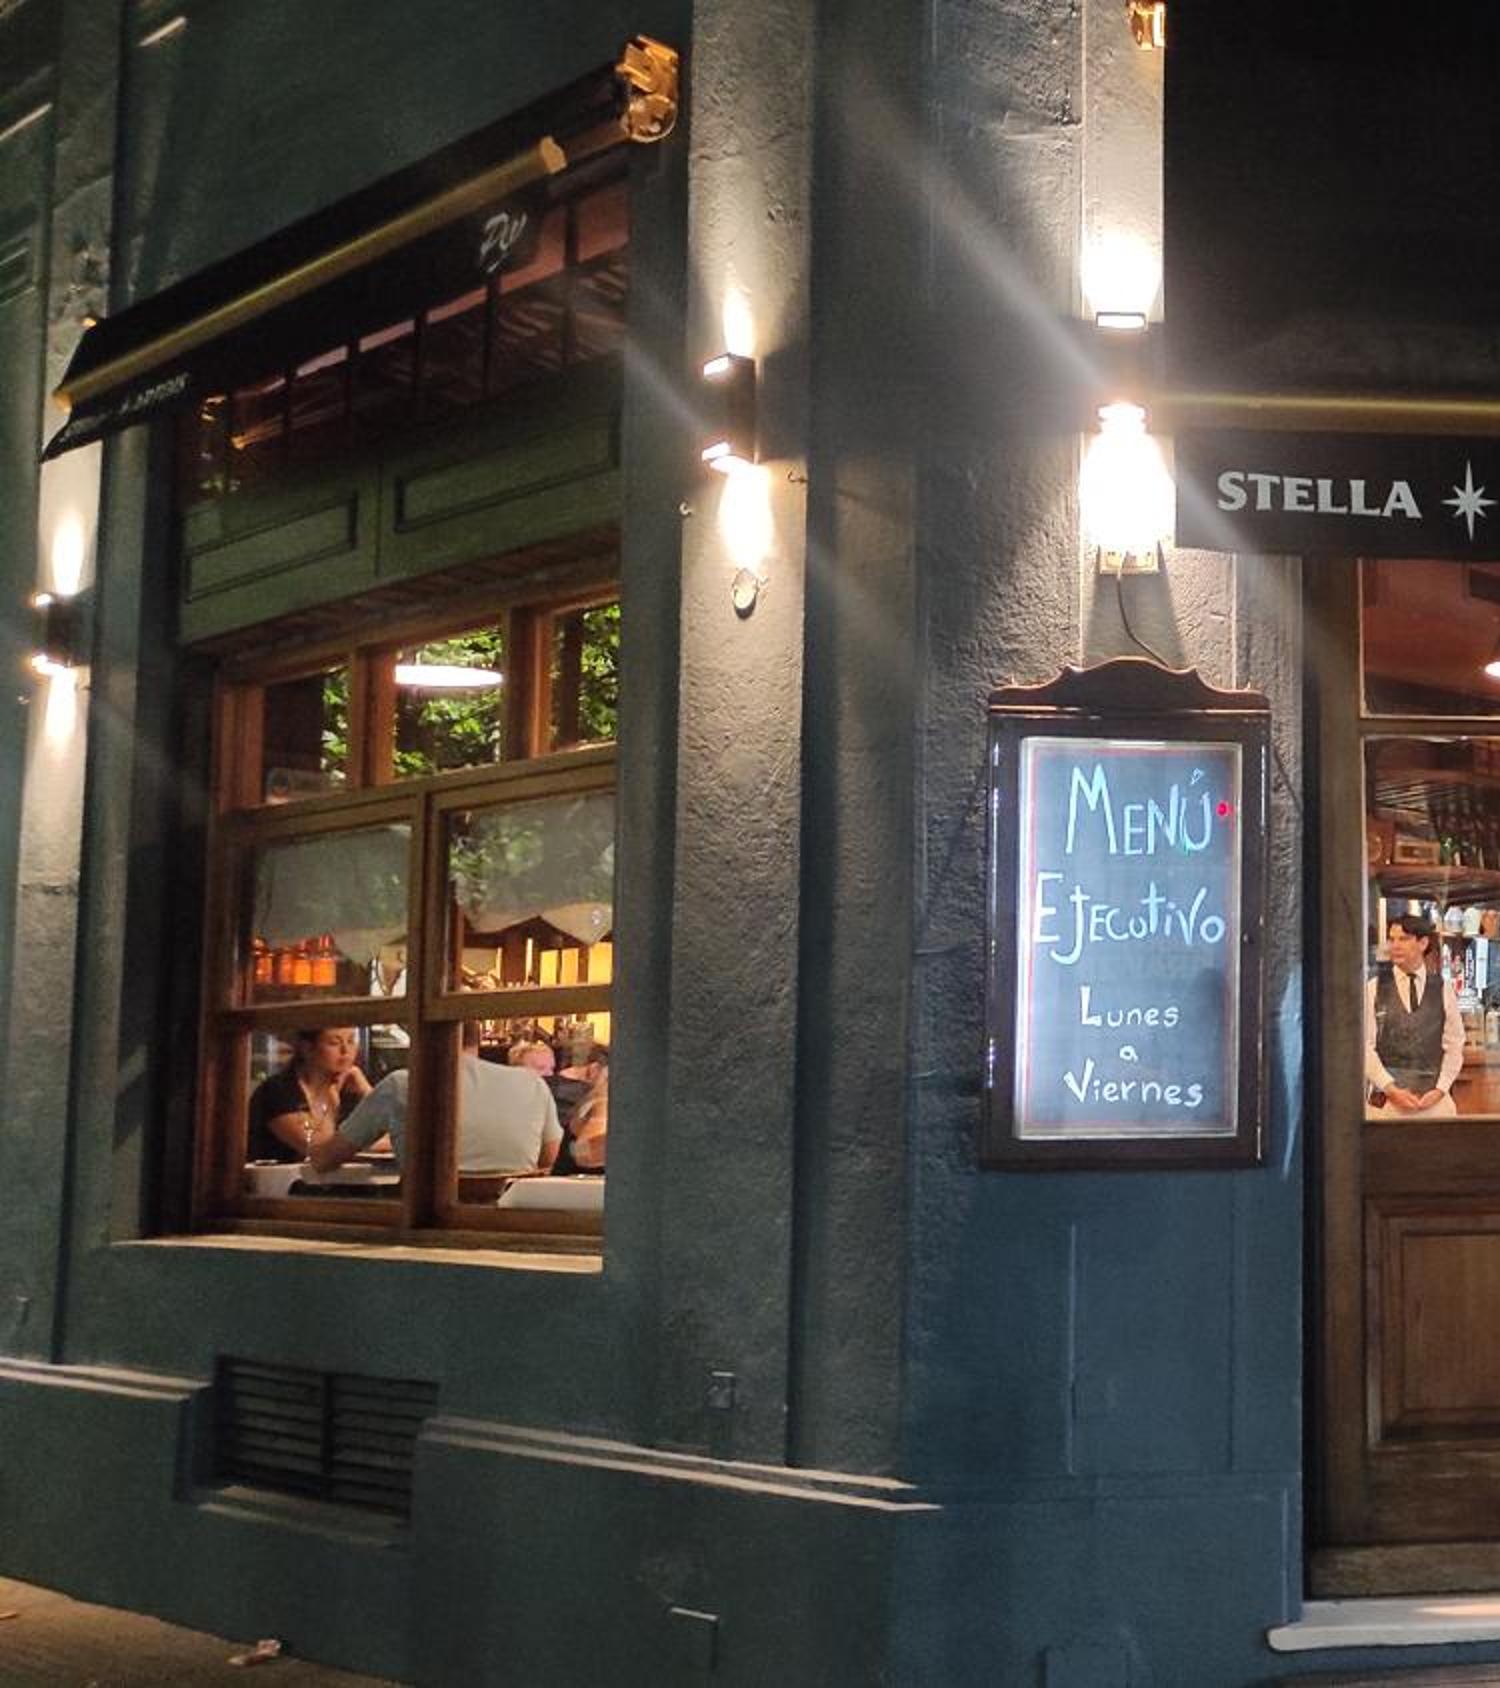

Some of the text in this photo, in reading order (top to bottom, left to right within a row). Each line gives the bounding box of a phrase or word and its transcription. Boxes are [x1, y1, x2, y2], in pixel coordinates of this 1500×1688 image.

[1217, 471, 1423, 519] STELLA
[1081, 985, 1180, 1028] Lunes
[1119, 1045, 1139, 1062] a
[1063, 1059, 1204, 1107] Viernes
